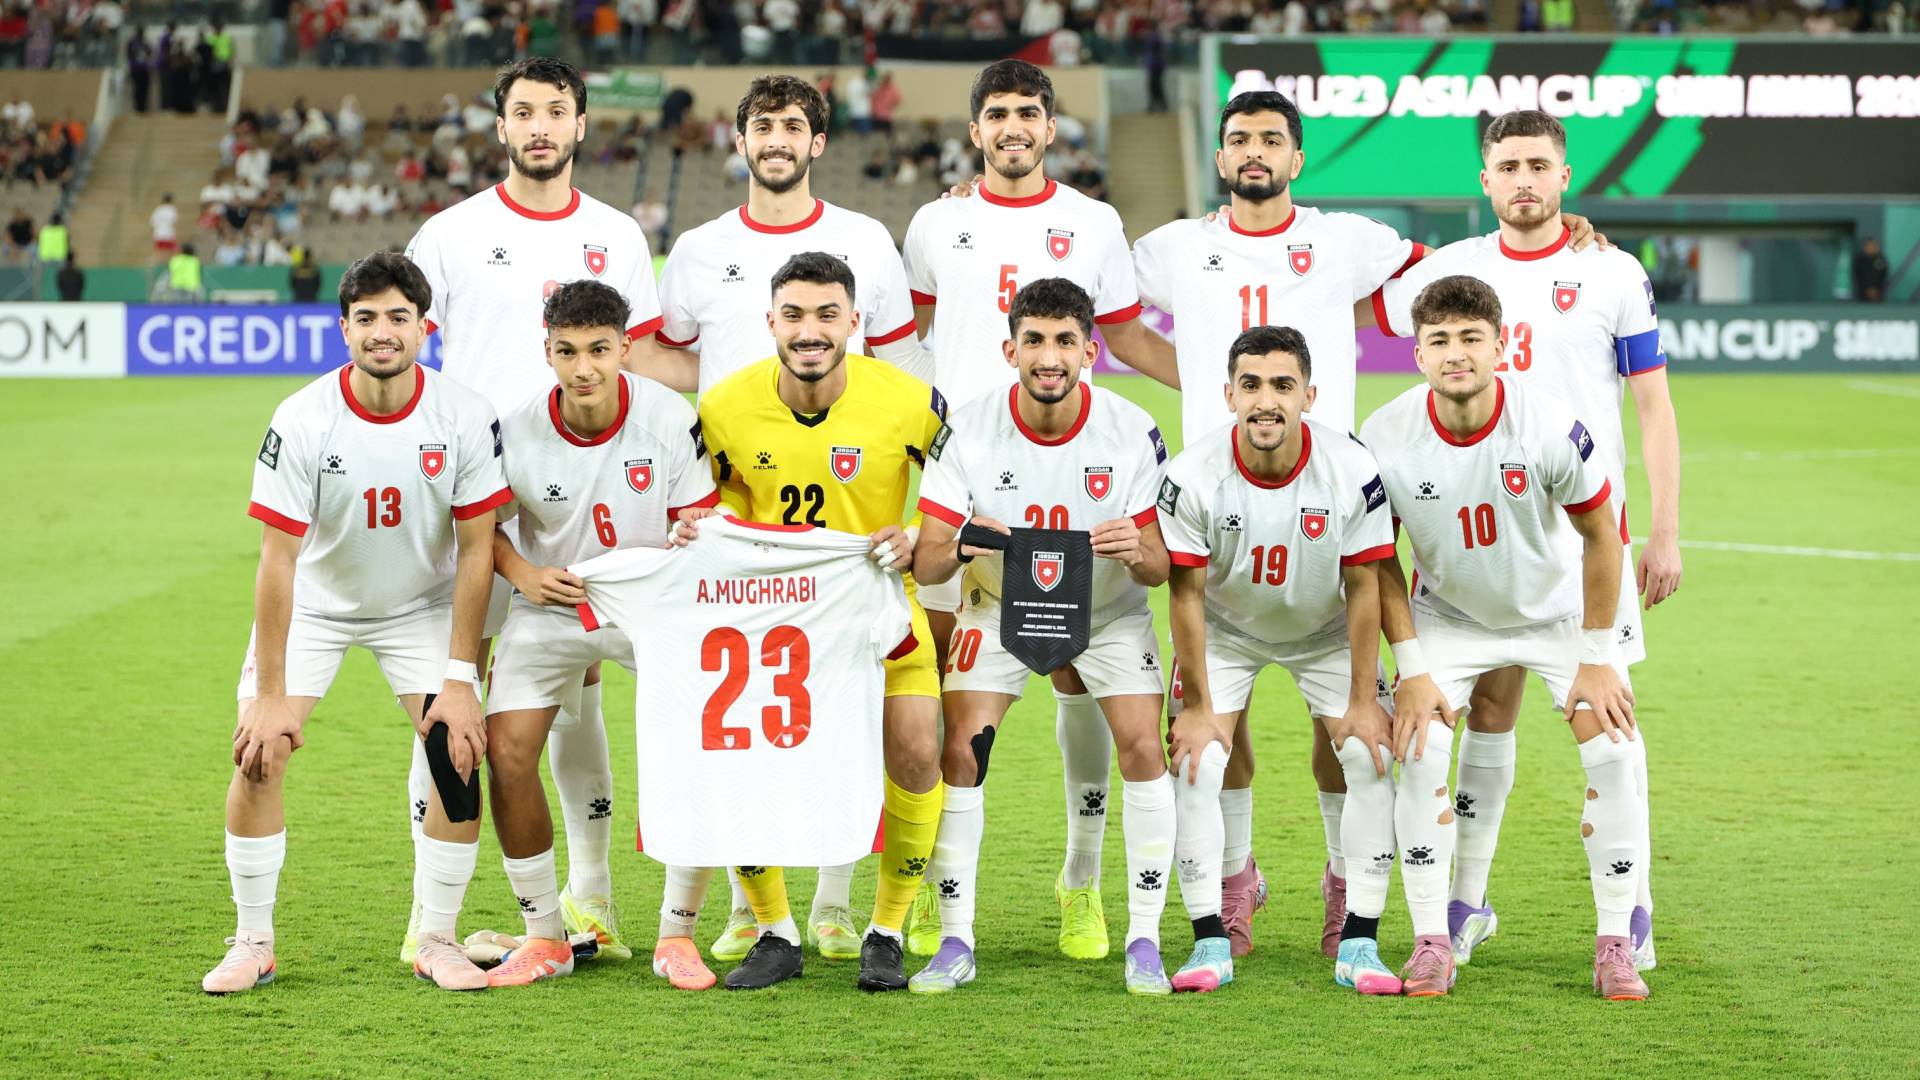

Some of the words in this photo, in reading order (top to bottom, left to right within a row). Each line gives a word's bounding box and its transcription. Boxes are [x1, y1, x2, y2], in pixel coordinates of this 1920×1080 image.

[1297, 76, 1387, 117] U23
[1390, 76, 1538, 117] ASIAN
[1539, 76, 1642, 117] CUP
[998, 264, 1018, 313] 5
[1238, 285, 1268, 332] 11
[138, 314, 334, 364] CREDIT
[1720, 319, 1819, 360] CUP
[322, 468, 347, 476] KELME
[363, 487, 402, 529] 13
[592, 503, 618, 548] 6
[780, 483, 827, 528] 22
[1457, 503, 1498, 549] 10
[1251, 544, 1288, 587] 19
[696, 576, 817, 605] A.MUGHRABI
[700, 624, 811, 751] 23
[1079, 808, 1105, 816] KELME
[1404, 858, 1435, 866] KELME
[671, 908, 697, 917] KELME
